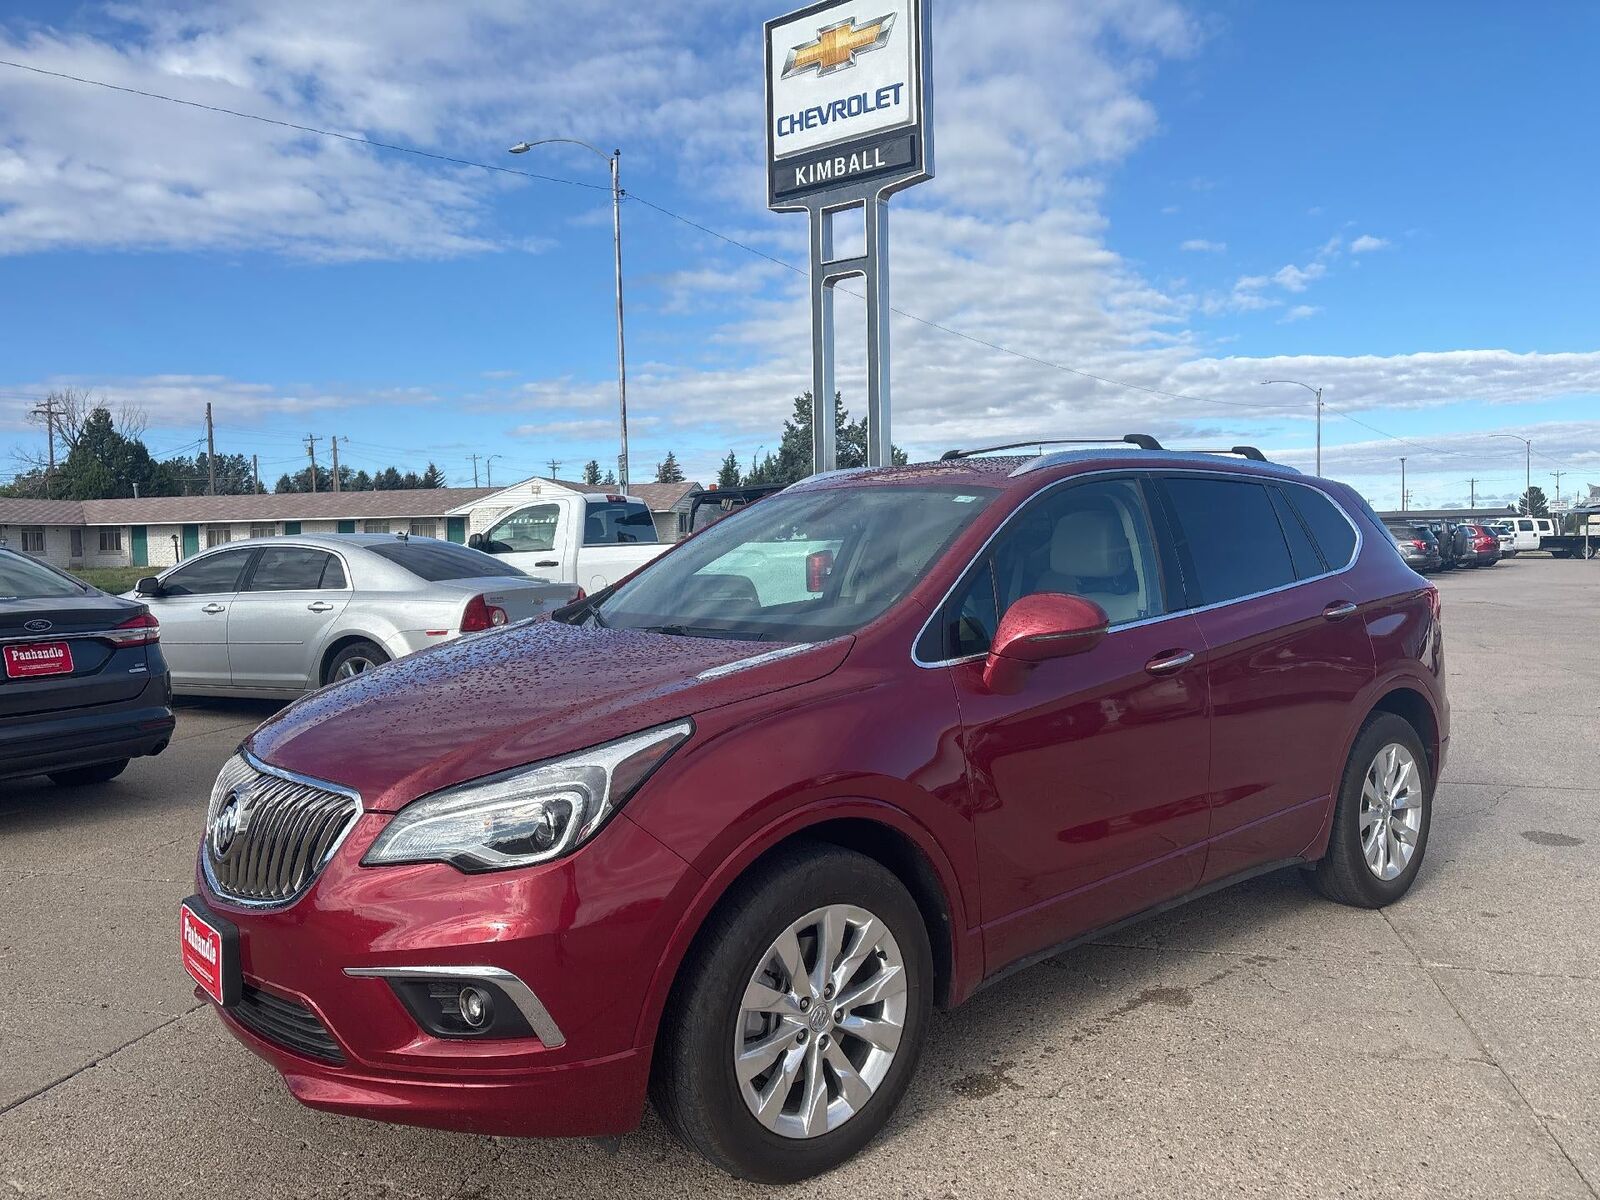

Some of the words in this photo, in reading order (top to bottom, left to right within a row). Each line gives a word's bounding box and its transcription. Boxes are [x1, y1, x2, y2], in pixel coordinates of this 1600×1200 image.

[777, 82, 903, 137] CHEVROLET
[796, 148, 886, 185] KIMBALL
[12, 648, 63, 661] Panhandle
[184, 916, 217, 965] Panhandle
